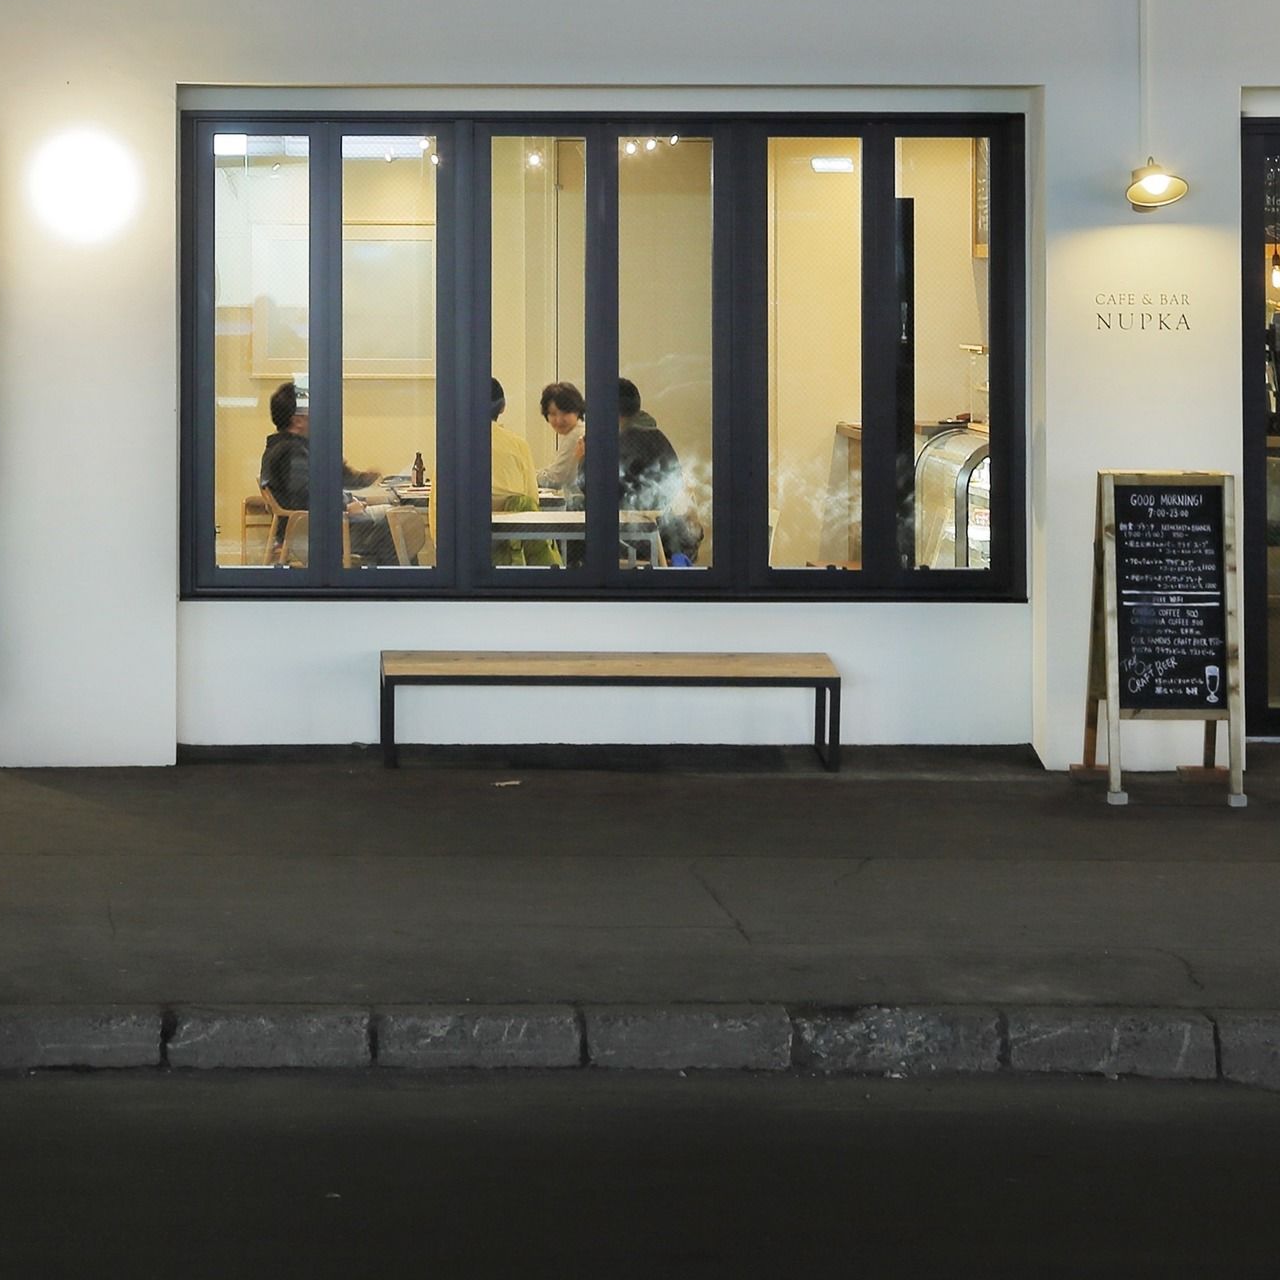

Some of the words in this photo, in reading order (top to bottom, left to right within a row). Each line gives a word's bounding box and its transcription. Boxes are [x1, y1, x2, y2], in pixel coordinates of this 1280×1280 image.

[1095, 293, 1135, 306] CAFE
[1141, 293, 1153, 306] &
[1160, 293, 1191, 306] BAR
[1096, 312, 1191, 331] NUPKA
[1130, 494, 1156, 506] GOOD
[1154, 656, 1178, 677] BEER
